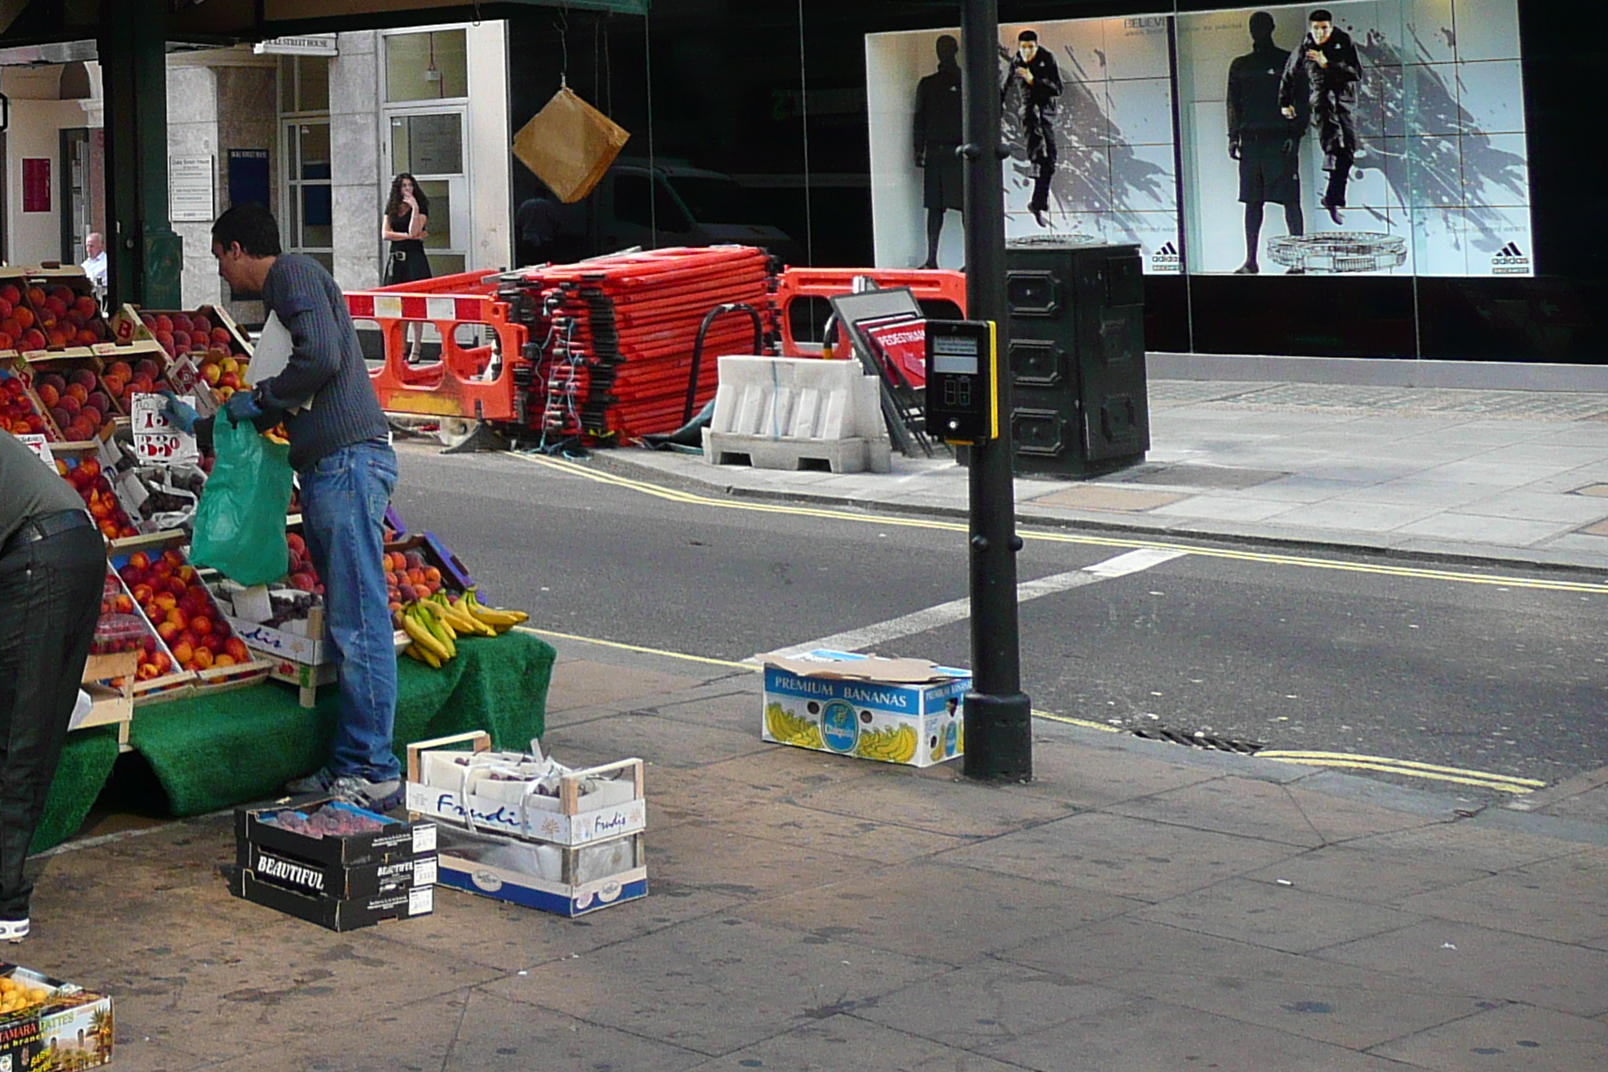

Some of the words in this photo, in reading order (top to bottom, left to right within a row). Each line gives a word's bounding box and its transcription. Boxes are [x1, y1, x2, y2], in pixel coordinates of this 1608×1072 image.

[307, 39, 328, 47] HOUSE
[1492, 257, 1529, 265] adidas
[775, 676, 833, 696] PREMIUM
[844, 686, 907, 707] BANANAS
[258, 855, 324, 890] BEAUTIFUL
[378, 856, 414, 876] BEAUTIFUL
[39, 1012, 75, 1031] DATTES
